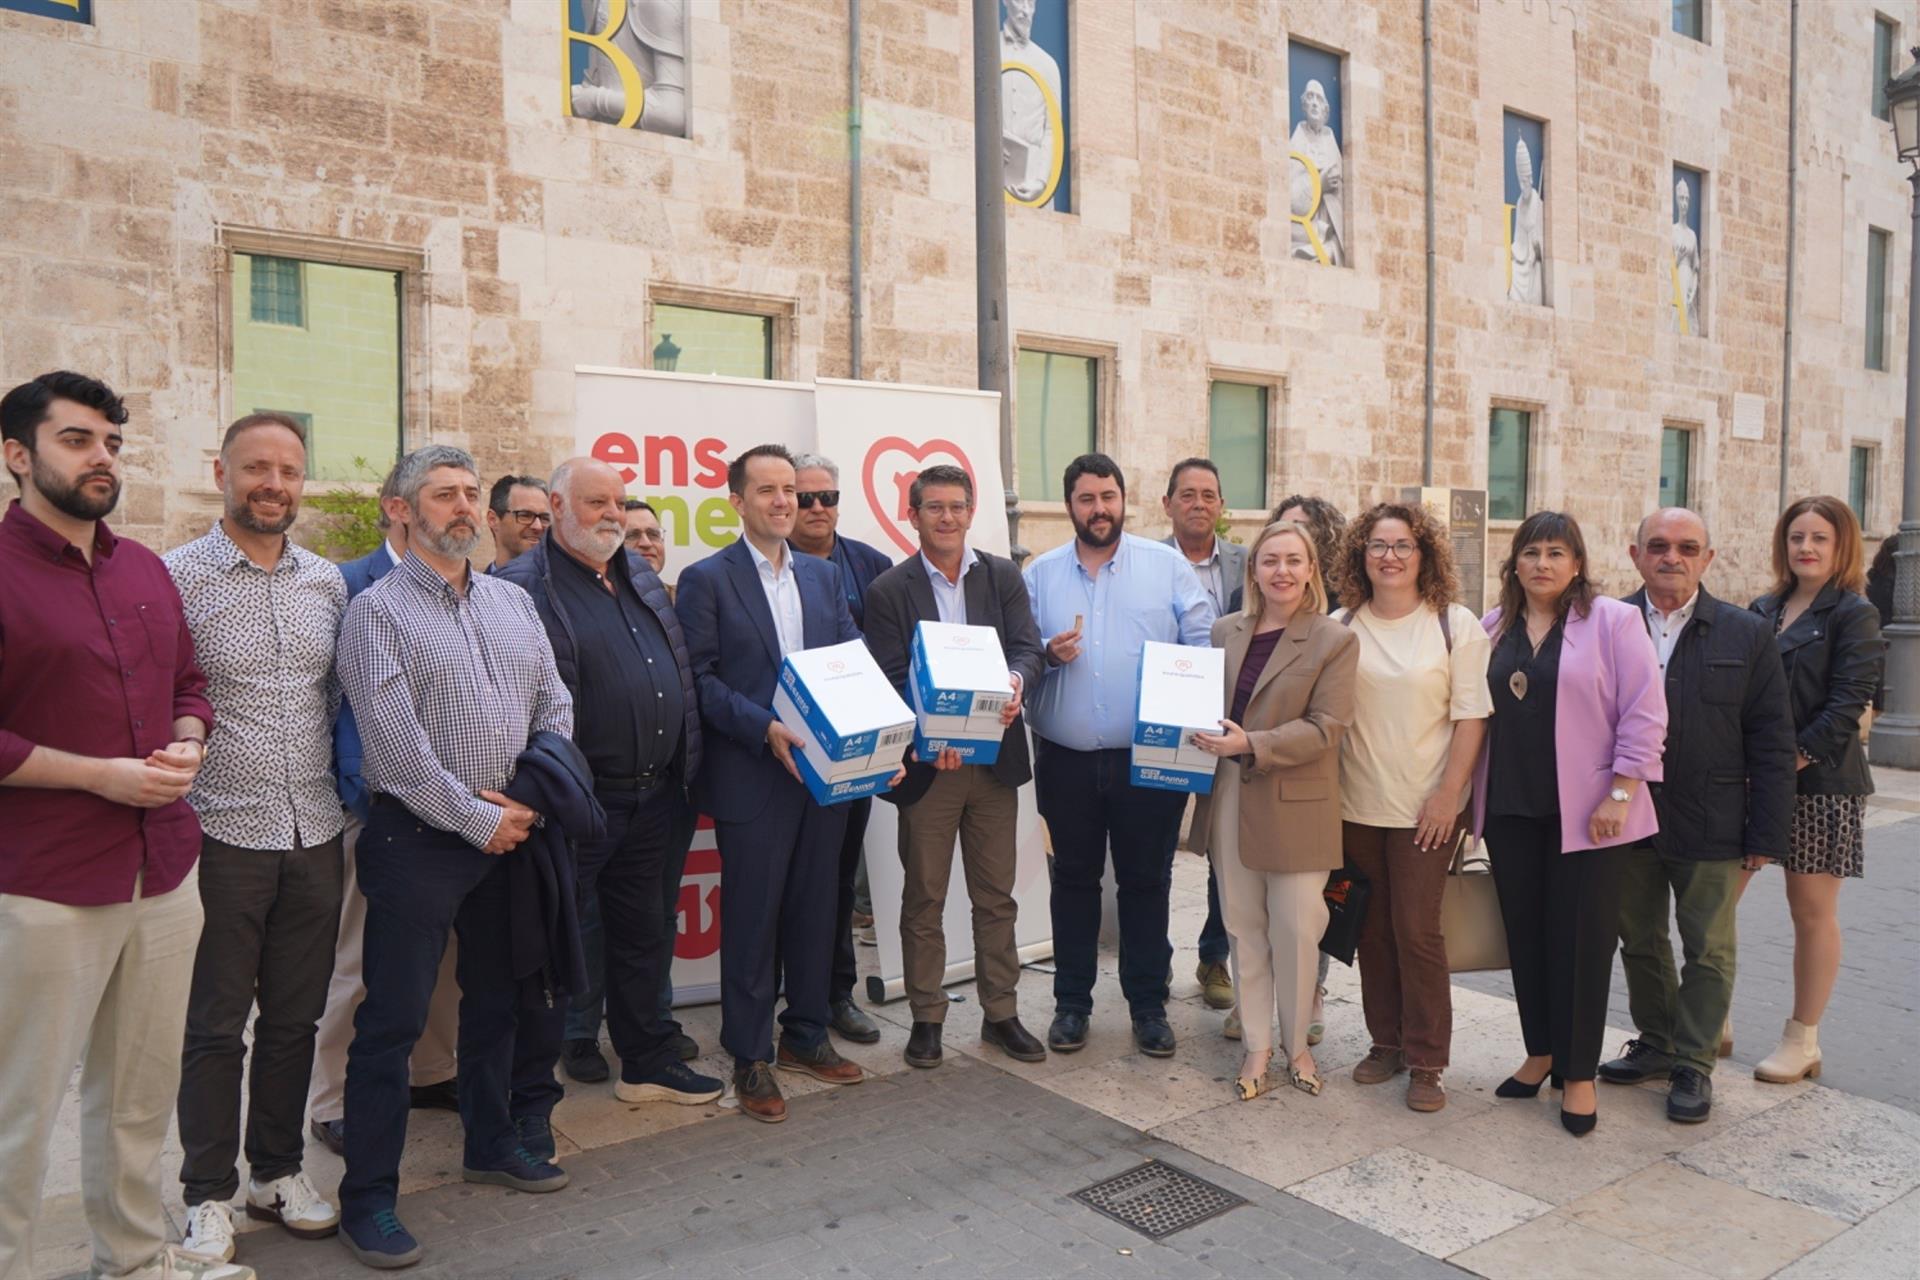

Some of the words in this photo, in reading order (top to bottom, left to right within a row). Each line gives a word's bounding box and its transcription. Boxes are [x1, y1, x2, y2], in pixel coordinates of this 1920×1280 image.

[592, 432, 730, 489] ens
[937, 691, 957, 701] A4
[1145, 725, 1164, 735] A4
[844, 736, 863, 748] A4
